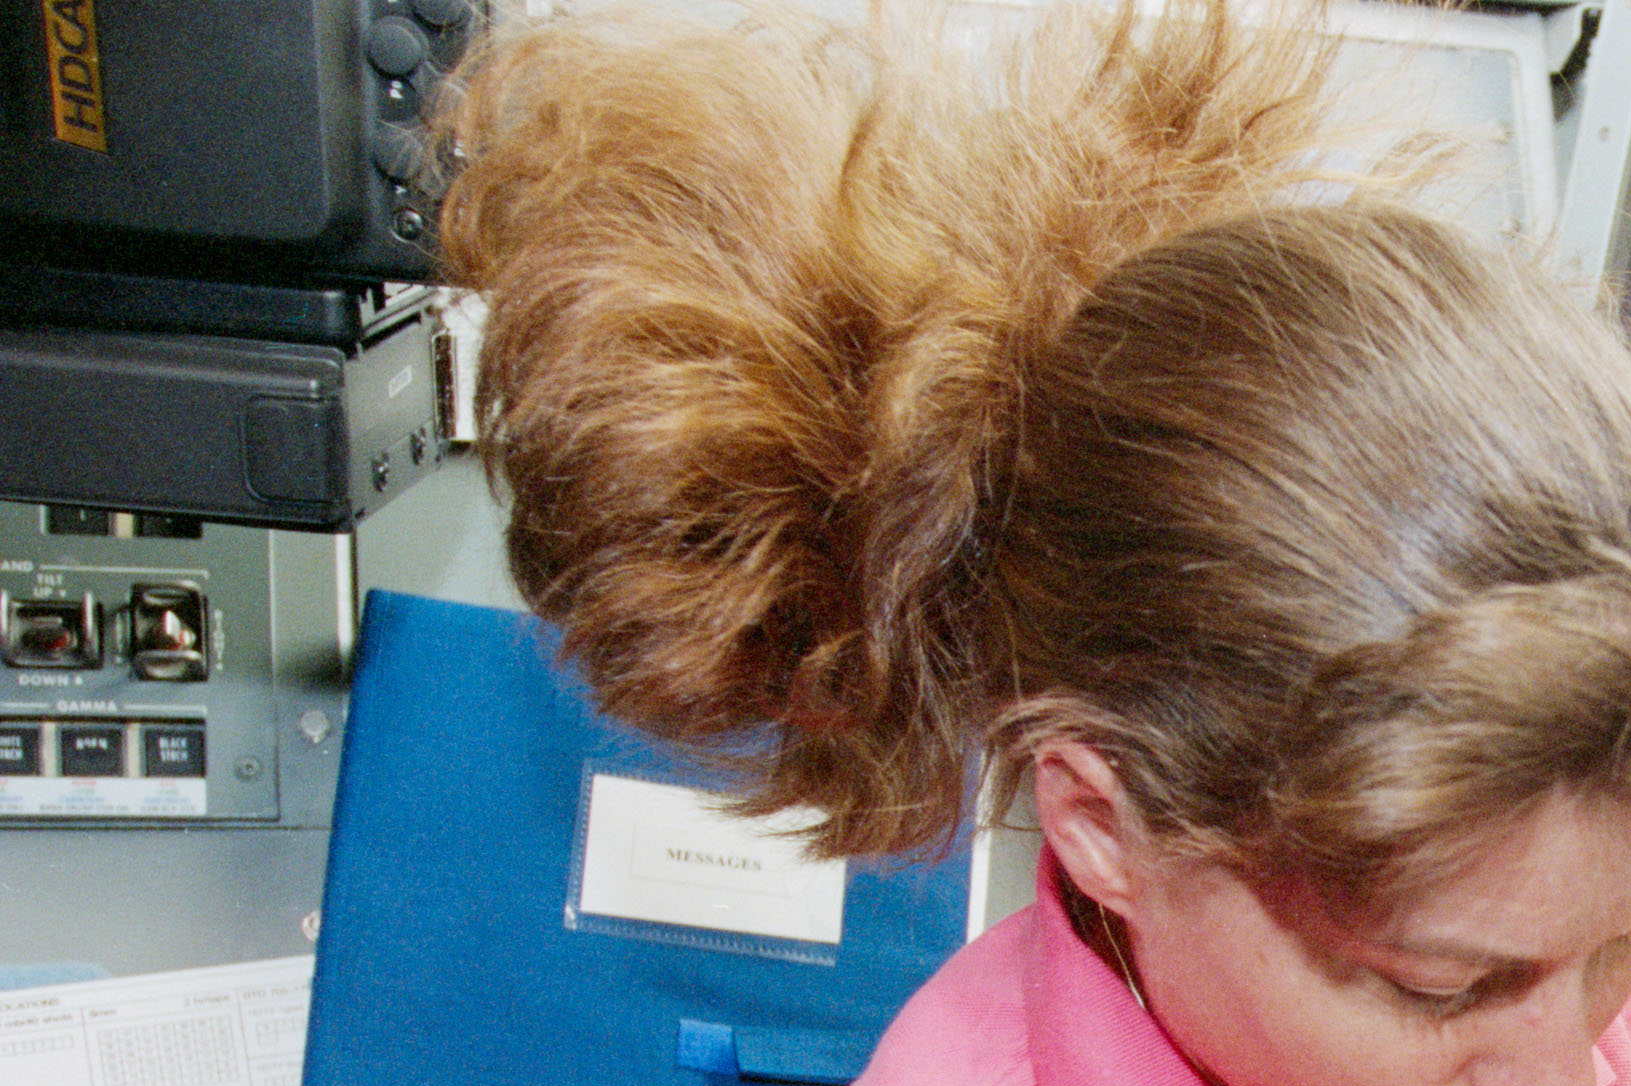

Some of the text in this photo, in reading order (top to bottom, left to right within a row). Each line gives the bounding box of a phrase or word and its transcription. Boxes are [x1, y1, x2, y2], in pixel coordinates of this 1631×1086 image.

[18, 673, 69, 687] DOWN
[56, 699, 118, 714] GAMMA
[665, 847, 763, 872] MESSAGES
